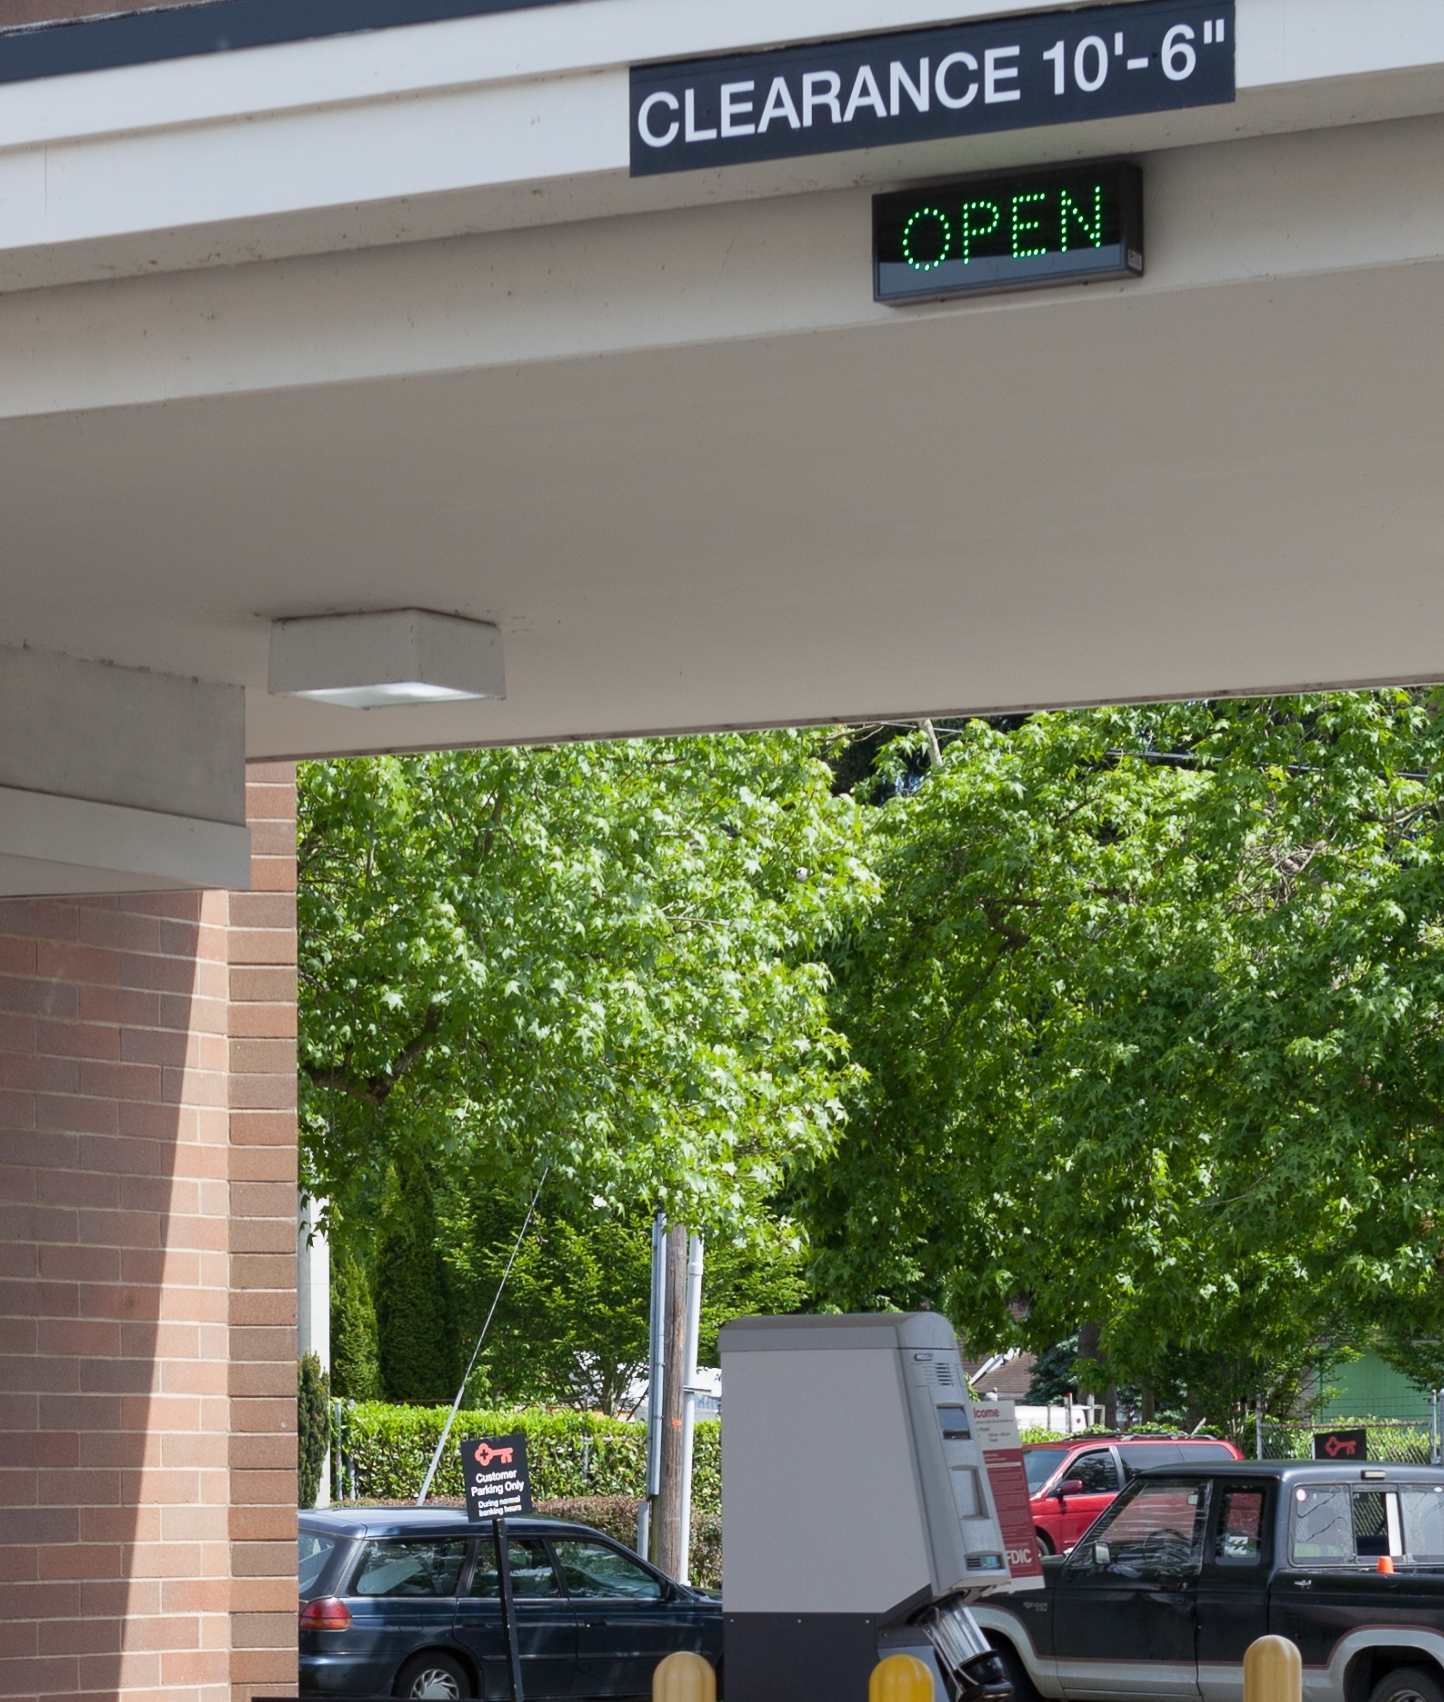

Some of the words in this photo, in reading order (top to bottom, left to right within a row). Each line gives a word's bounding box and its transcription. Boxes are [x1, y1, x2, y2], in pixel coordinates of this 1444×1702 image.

[637, 45, 1022, 149] CLEARANCE
[1042, 19, 1226, 96] 10'-6"
[902, 186, 1103, 273] OPEN
[475, 1470, 517, 1484] Customer
[471, 1484, 503, 1497] Parking
[505, 1480, 524, 1492] Only
[478, 1499, 498, 1508] During
